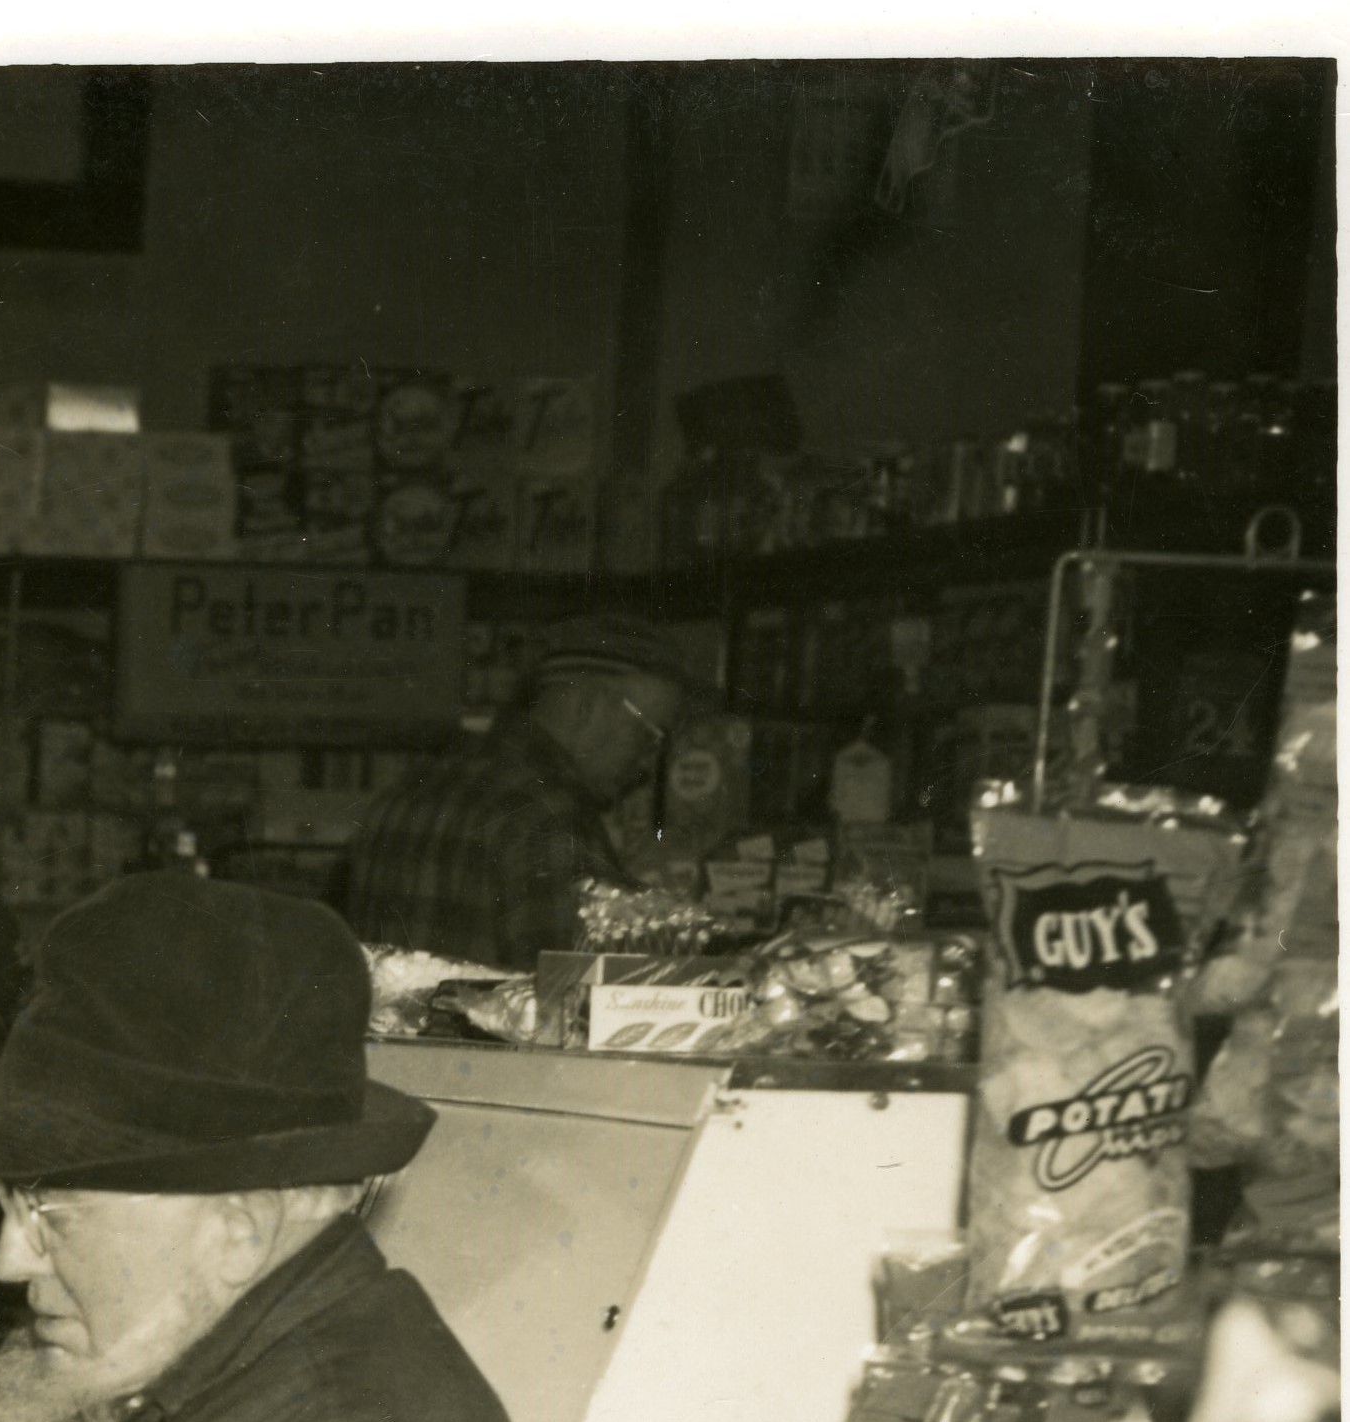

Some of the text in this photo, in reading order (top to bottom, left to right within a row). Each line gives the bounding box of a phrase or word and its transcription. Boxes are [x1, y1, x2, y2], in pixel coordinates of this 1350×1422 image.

[170, 574, 435, 641] Peter Pan
[1033, 892, 1157, 970] GUY'S
[698, 990, 749, 1018] CHO
